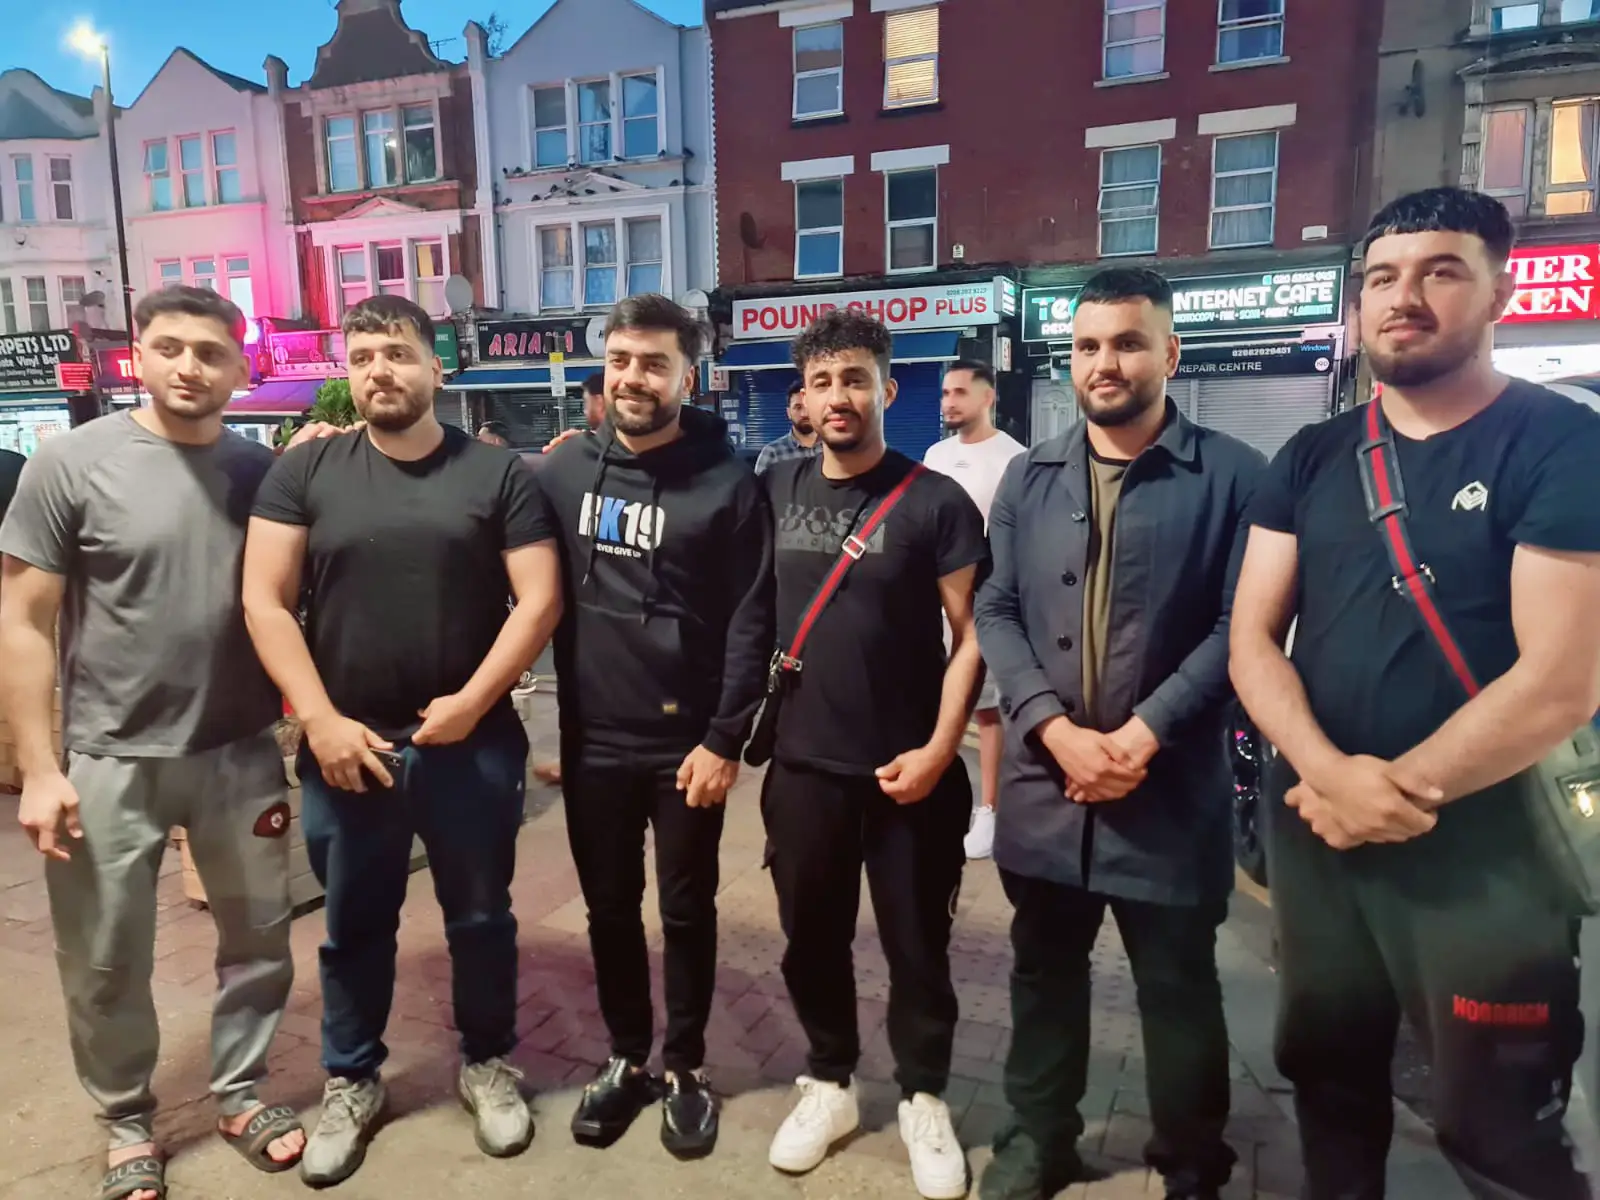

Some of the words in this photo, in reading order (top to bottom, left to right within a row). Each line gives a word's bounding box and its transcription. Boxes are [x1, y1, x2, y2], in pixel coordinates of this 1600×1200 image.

[1172, 286, 1271, 312] NTERNET
[1274, 281, 1334, 306] CAFE
[935, 296, 987, 316] PLUS
[40, 335, 70, 352] LTD
[489, 330, 573, 356] ARIAA
[16, 355, 40, 367] Vinyl
[1179, 363, 1216, 373] REPAIR
[1218, 361, 1262, 372] CENTRE
[780, 503, 872, 537] BOS
[596, 542, 614, 554] EVER
[613, 546, 632, 557] GIVE
